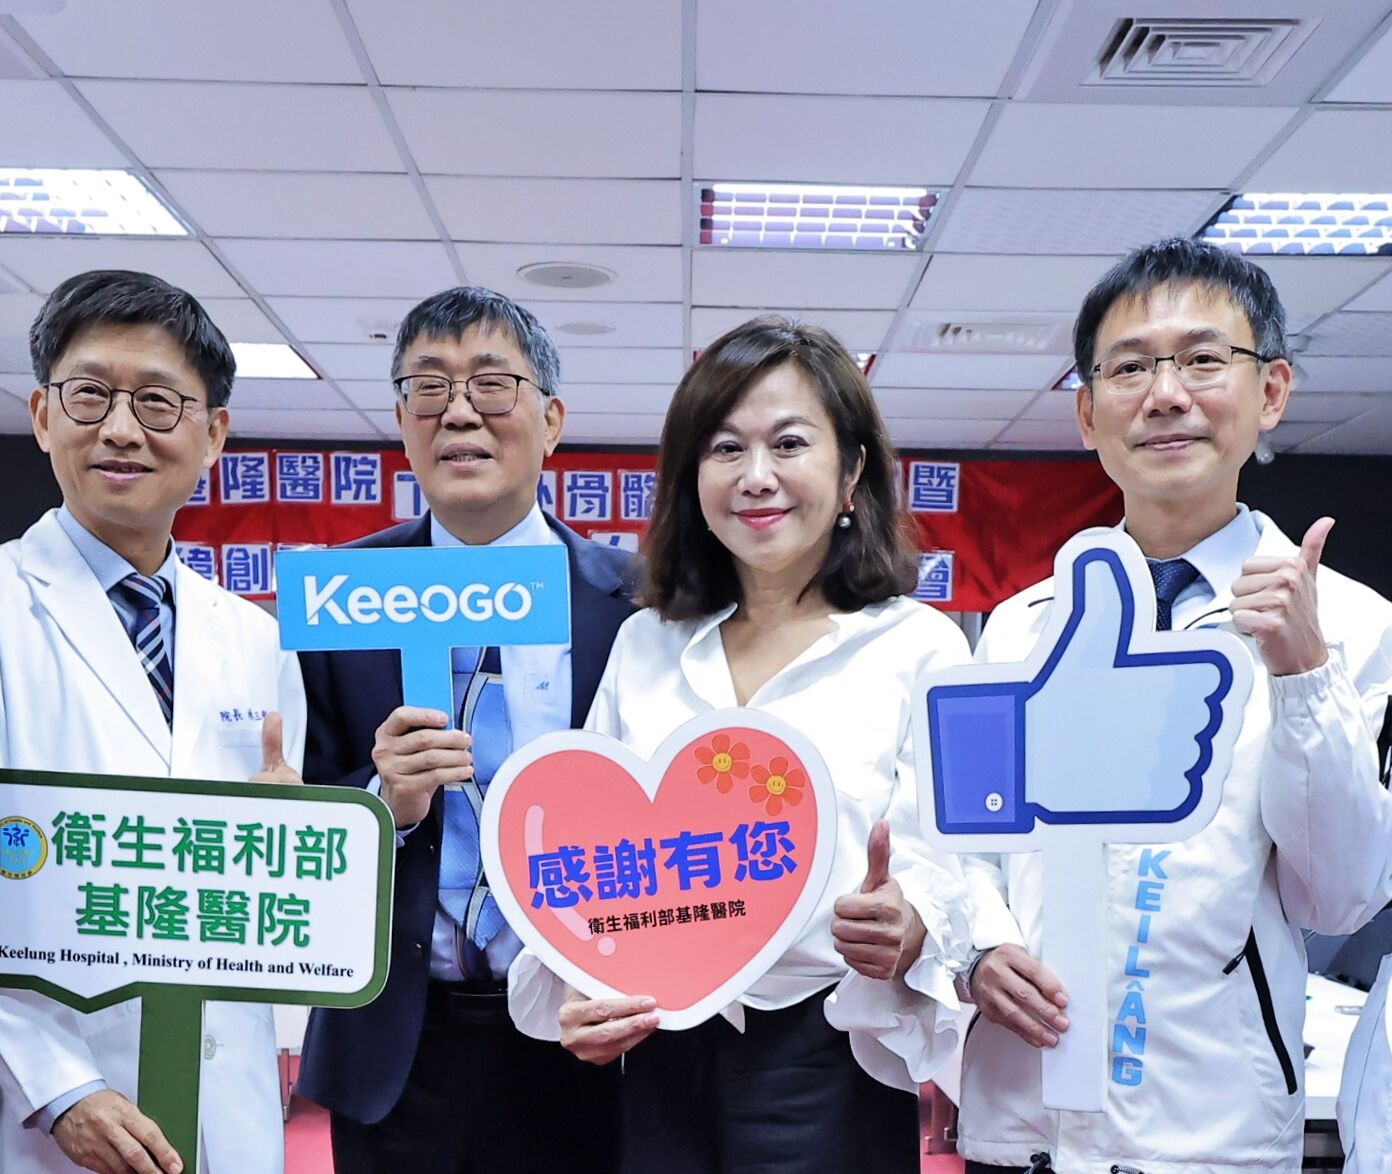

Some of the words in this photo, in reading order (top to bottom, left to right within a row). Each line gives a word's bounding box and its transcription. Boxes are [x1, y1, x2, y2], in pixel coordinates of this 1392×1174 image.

[912, 463, 957, 511] 暨
[528, 821, 798, 909] 感謝有您
[75, 881, 311, 948] 基隆醫院
[588, 899, 747, 935] 衛生福利部基隆醫院
[132, 953, 193, 971] Ministry
[198, 957, 214, 970] of
[216, 957, 263, 973] Health
[267, 961, 294, 974] and
[299, 963, 354, 978] Welfare
